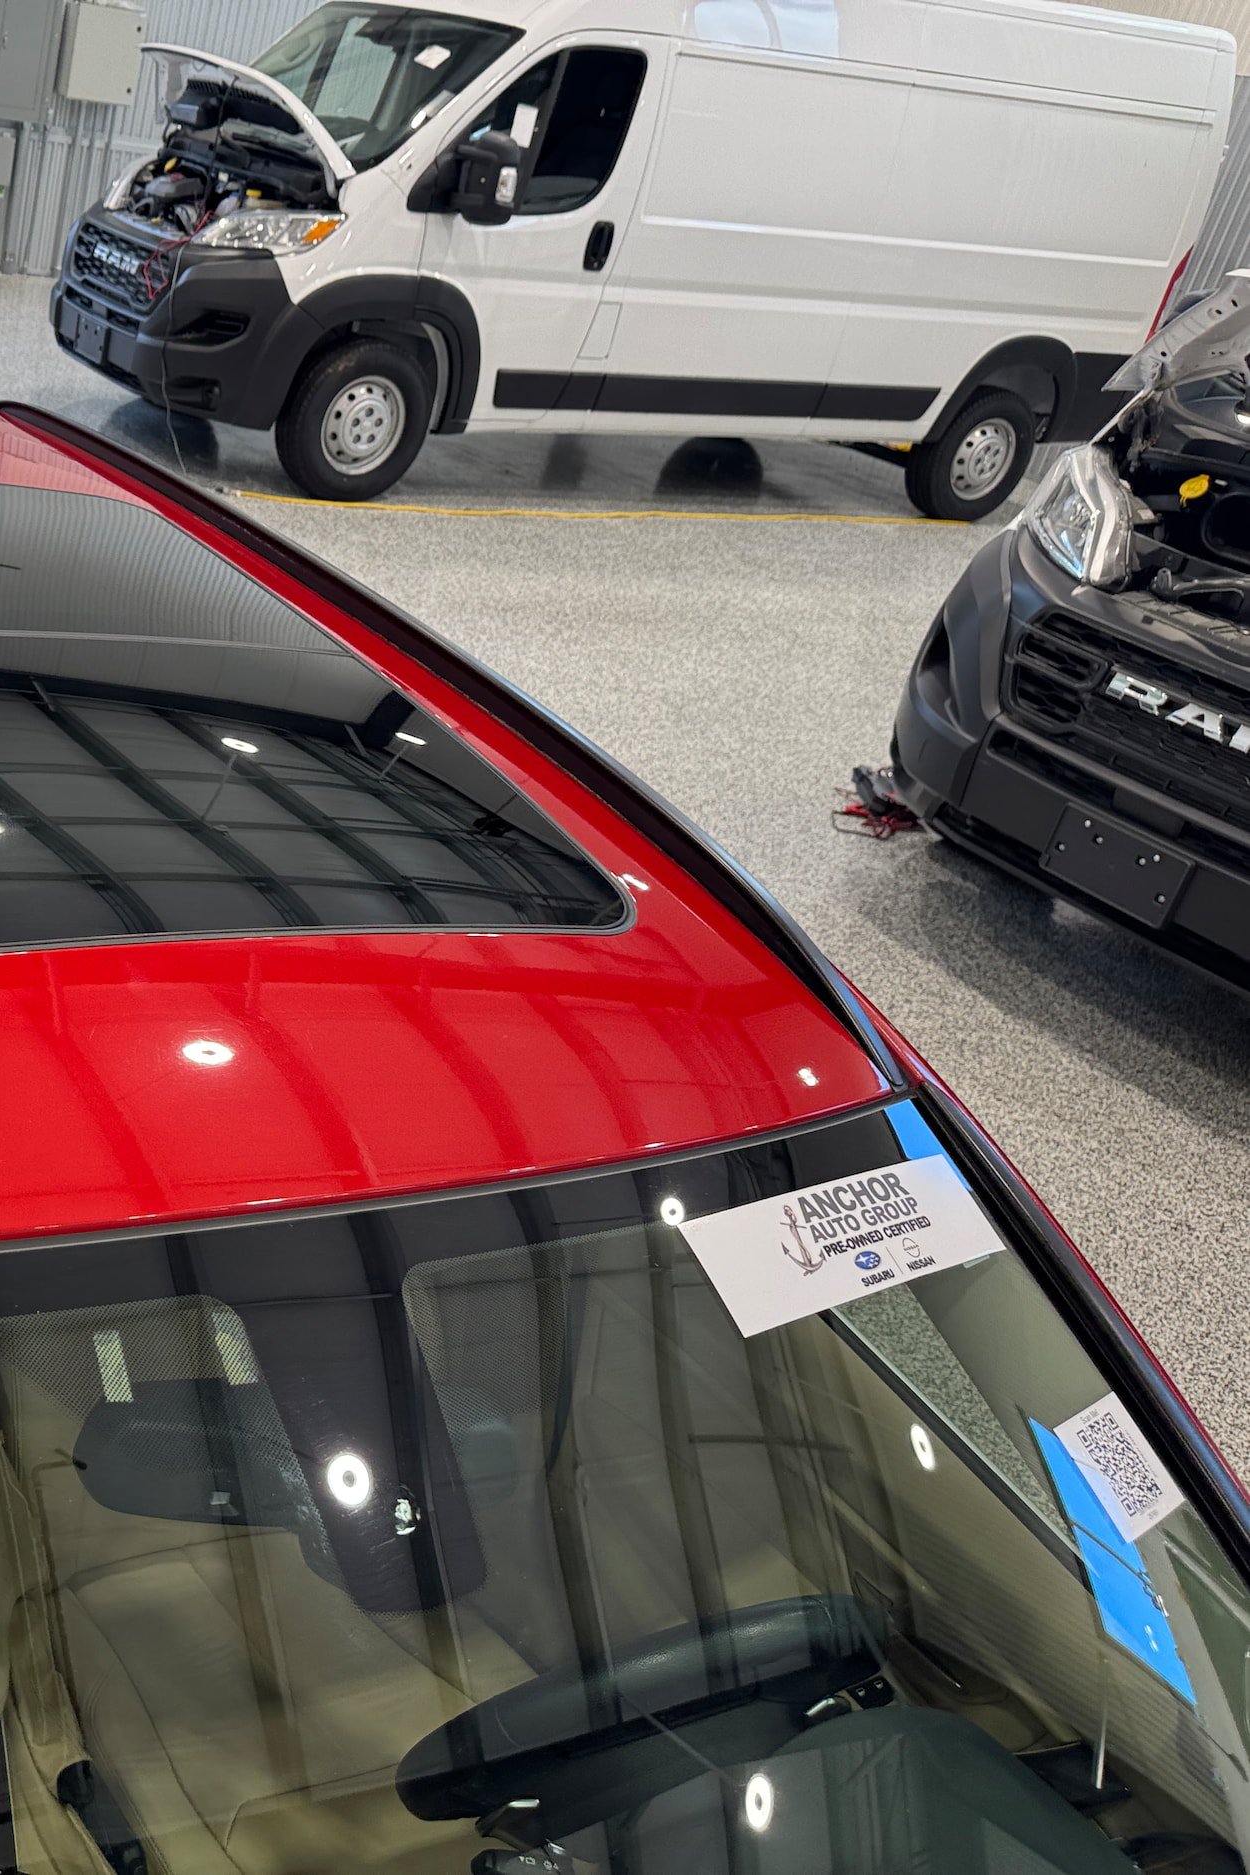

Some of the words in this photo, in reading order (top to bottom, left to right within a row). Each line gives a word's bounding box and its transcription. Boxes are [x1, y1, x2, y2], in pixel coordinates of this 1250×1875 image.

[93, 242, 139, 274] RAM
[798, 1172, 910, 1224] ANCHOR
[810, 1213, 861, 1244] AUTO
[861, 1196, 918, 1227] GROUP
[824, 1230, 883, 1257] PRE-OWNED
[883, 1216, 931, 1239] CERTIFIED
[861, 1269, 895, 1286] SUBARU
[906, 1256, 936, 1271] NISSAN
